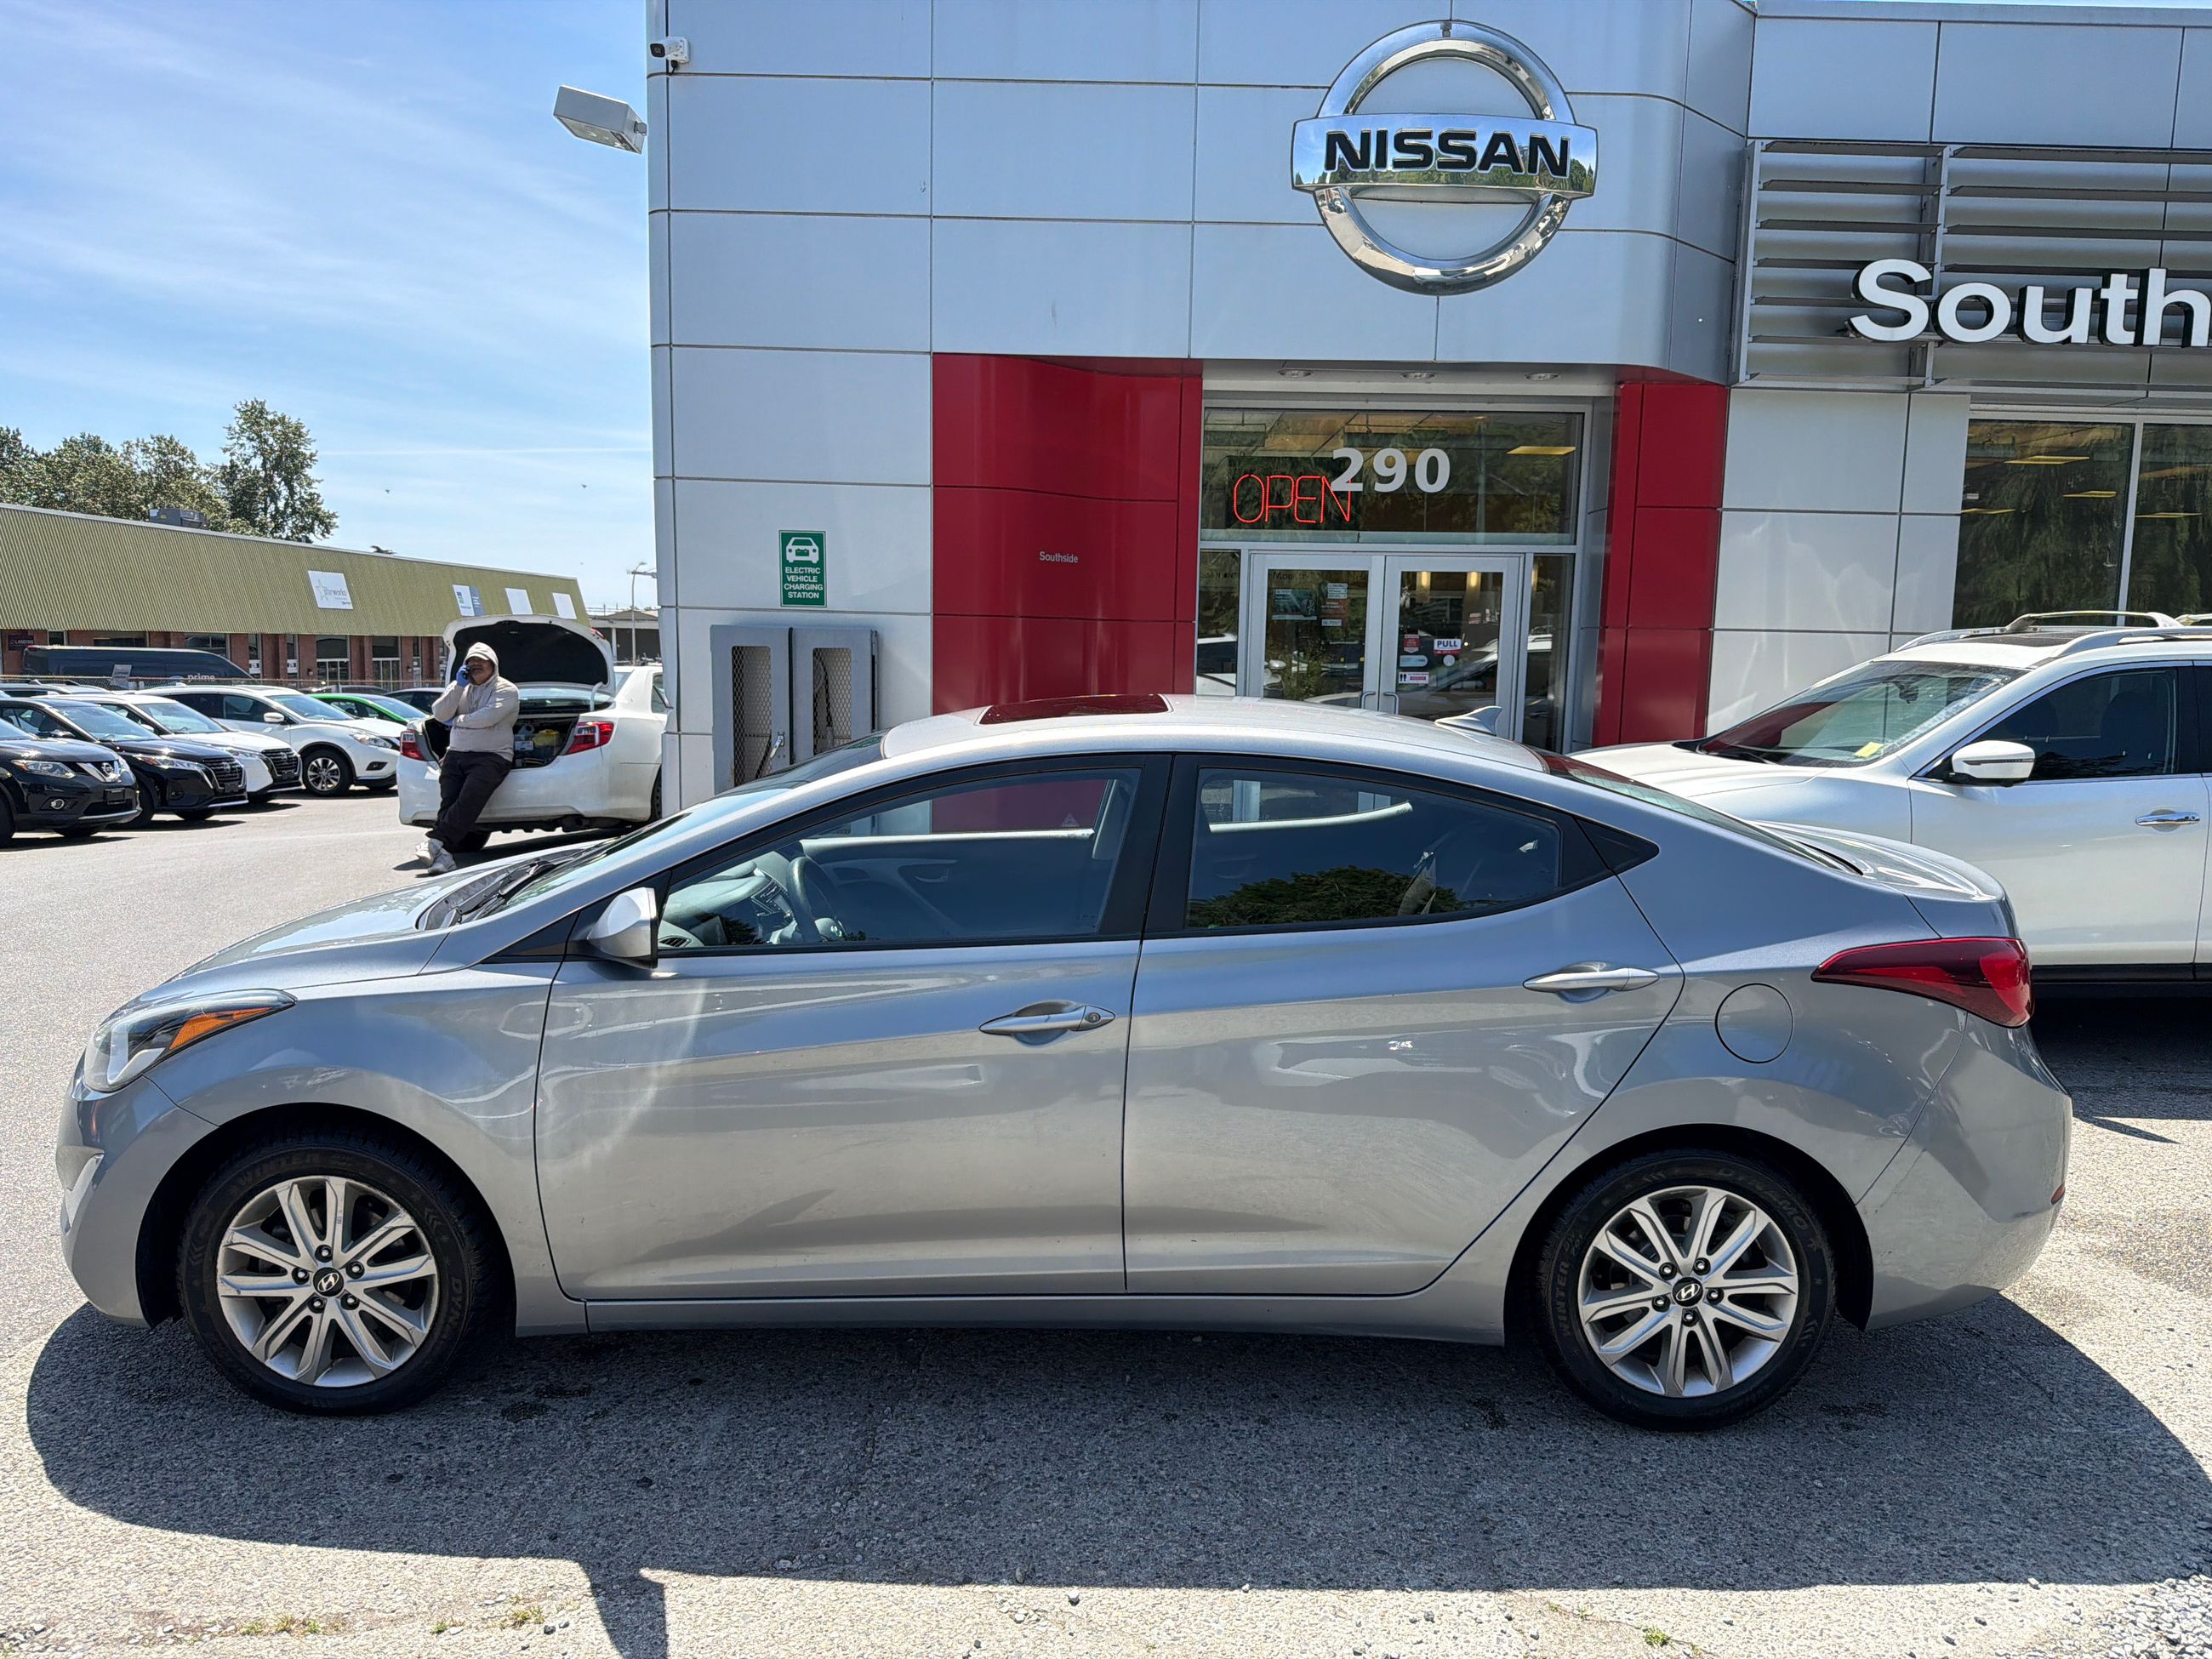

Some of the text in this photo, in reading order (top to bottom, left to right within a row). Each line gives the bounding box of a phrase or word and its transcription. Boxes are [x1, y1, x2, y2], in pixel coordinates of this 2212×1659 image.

[1324, 128, 1571, 179] NISSAN
[1849, 258, 2212, 346] South
[1331, 448, 1451, 493] 290
[1234, 473, 1354, 523] OPEN
[1040, 550, 1078, 563] Southside
[187, 673, 215, 682] prime
